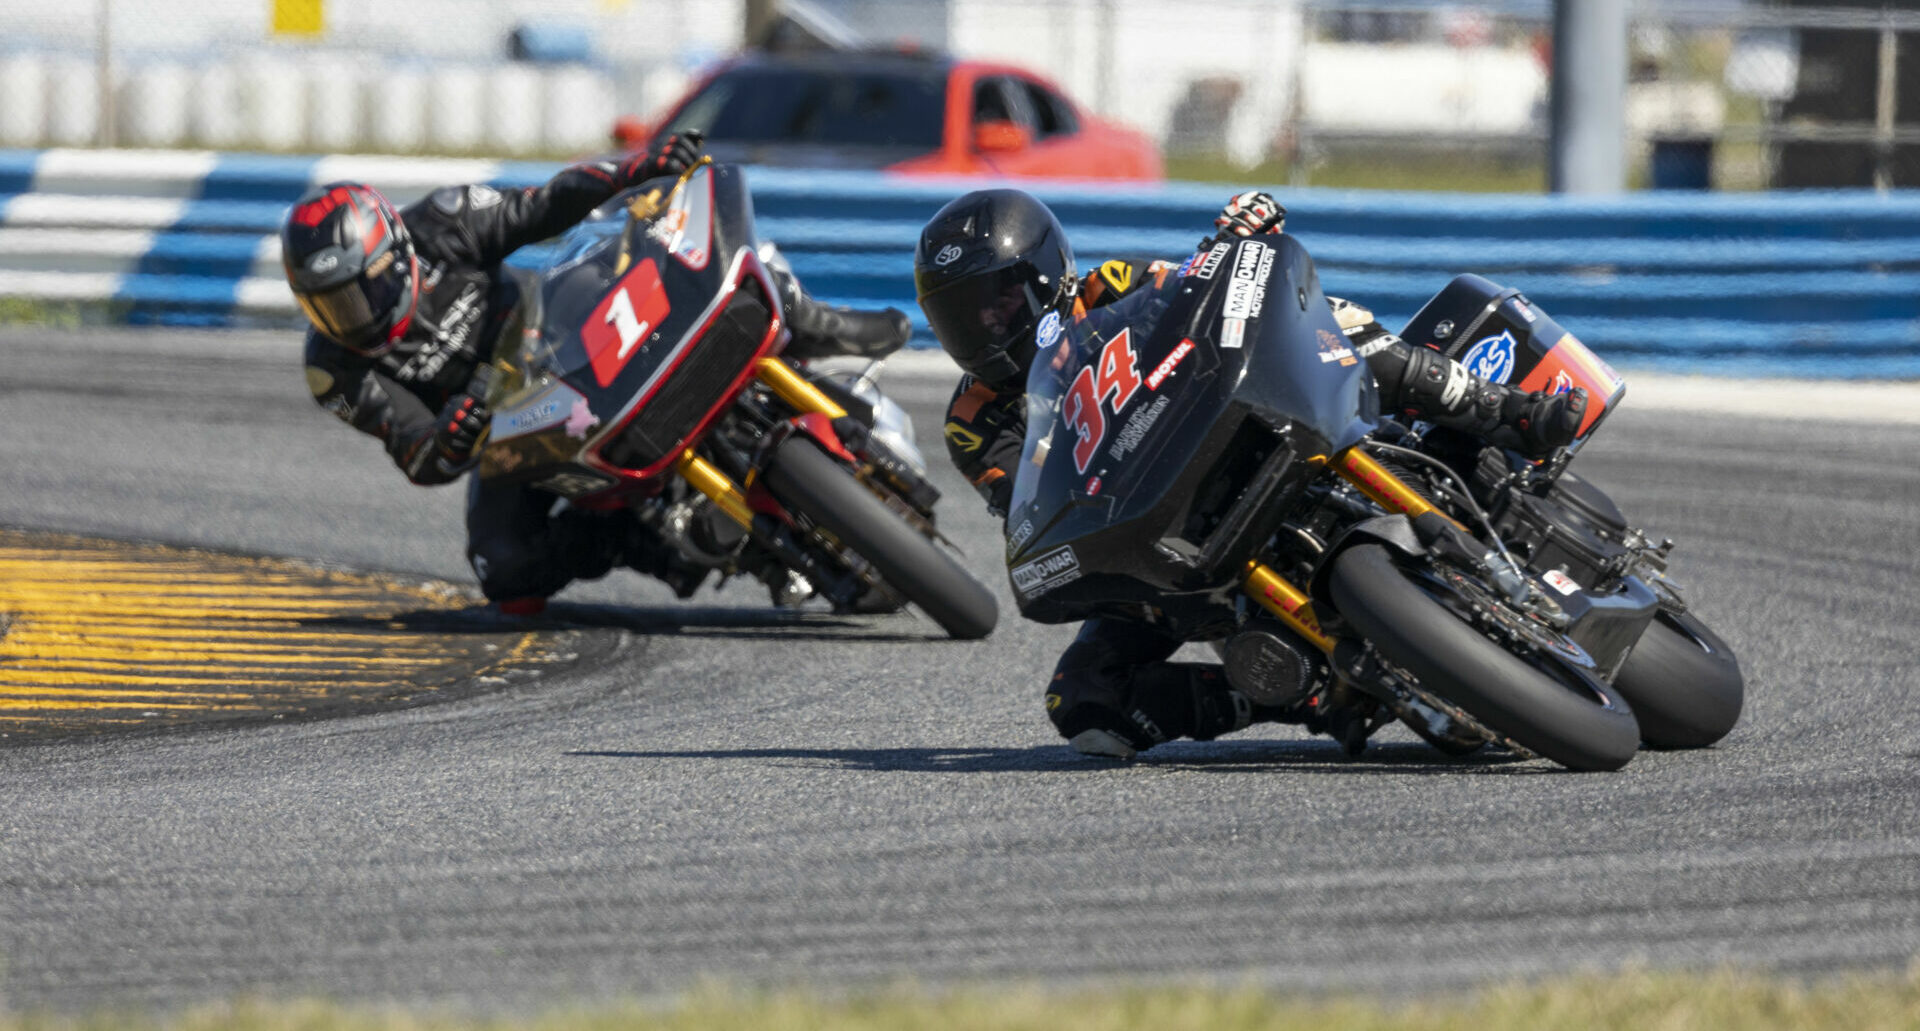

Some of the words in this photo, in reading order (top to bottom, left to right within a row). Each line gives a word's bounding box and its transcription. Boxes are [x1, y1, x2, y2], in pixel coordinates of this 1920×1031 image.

[1231, 281, 1249, 313] MAN
[1250, 286, 1267, 318] MOTOR
[1260, 248, 1276, 287] PRODUCTS
[605, 286, 649, 360] 1
[1148, 341, 1193, 387] MOTUL
[1062, 326, 1143, 475] 34
[1036, 551, 1075, 577] O-WAR
